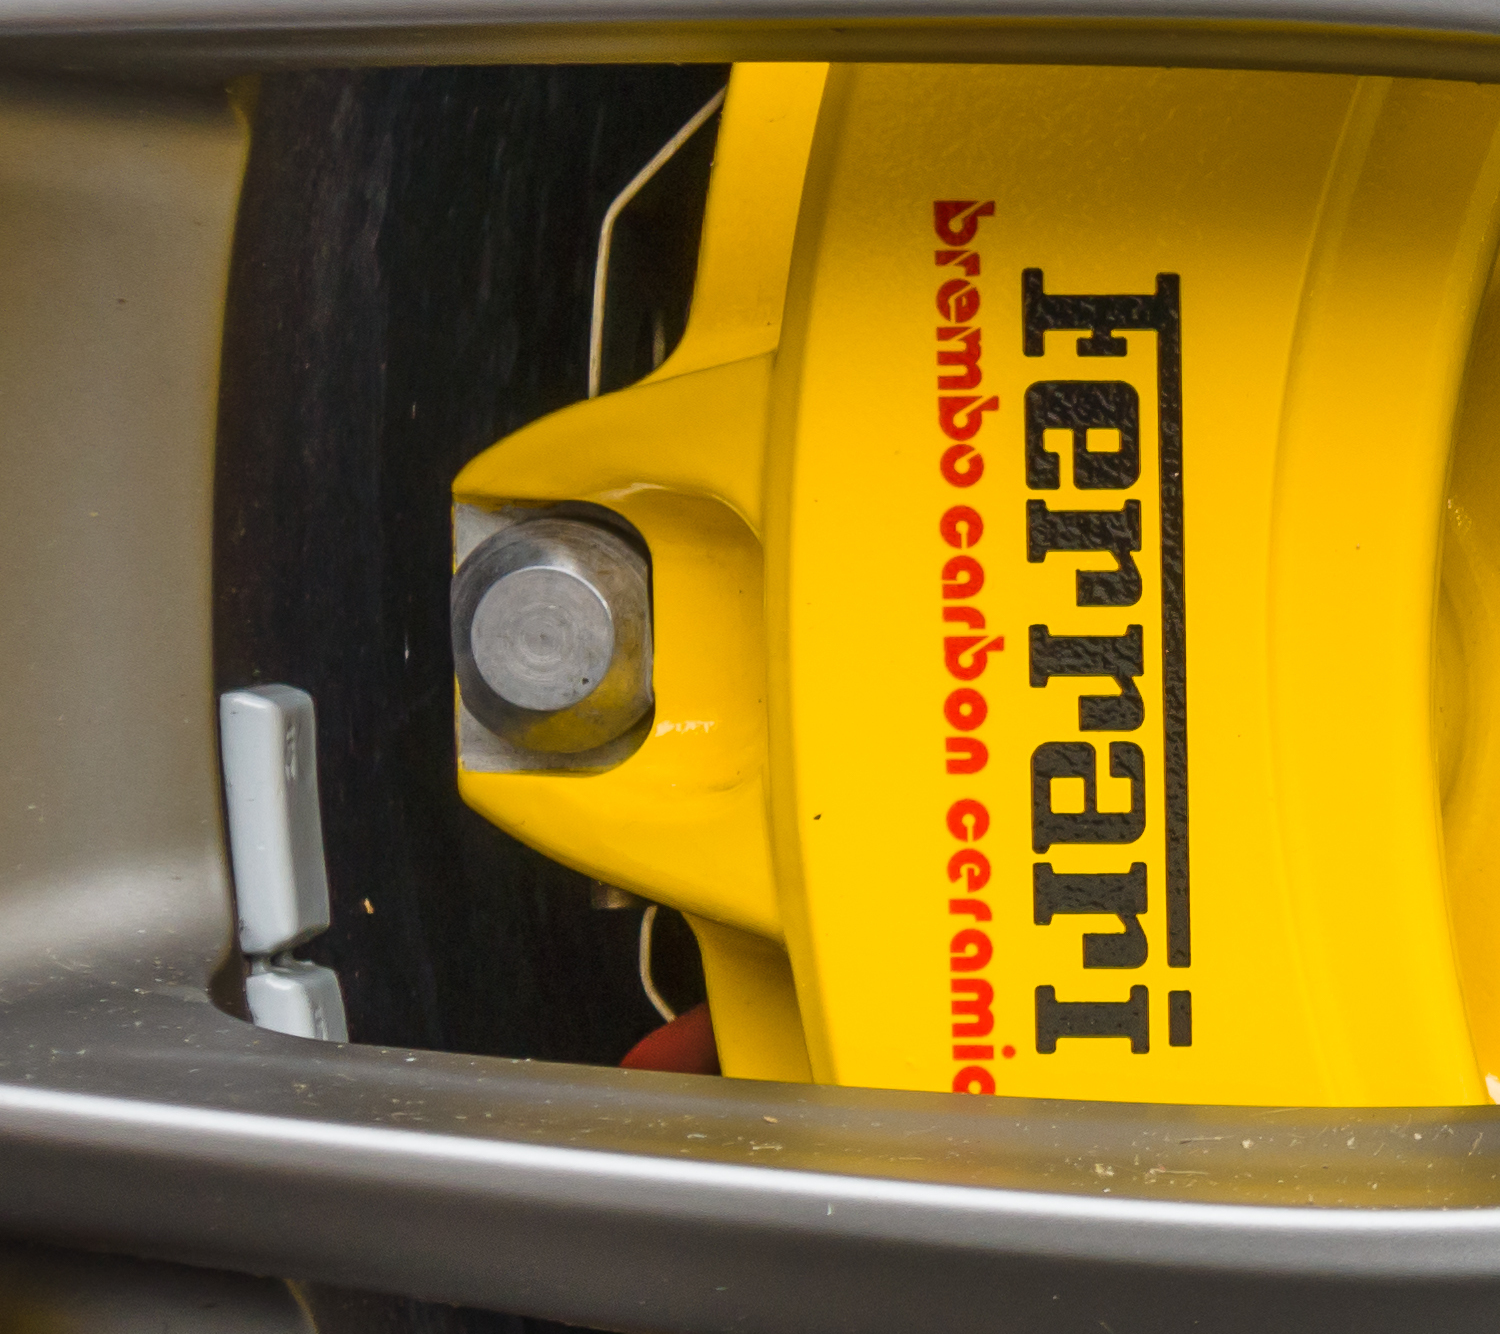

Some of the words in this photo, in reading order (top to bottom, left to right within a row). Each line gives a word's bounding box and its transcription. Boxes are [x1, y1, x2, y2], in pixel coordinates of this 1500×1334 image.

[935, 201, 998, 488] brembo
[940, 505, 1004, 774] carbon
[1022, 268, 1192, 1054] Ferrari
